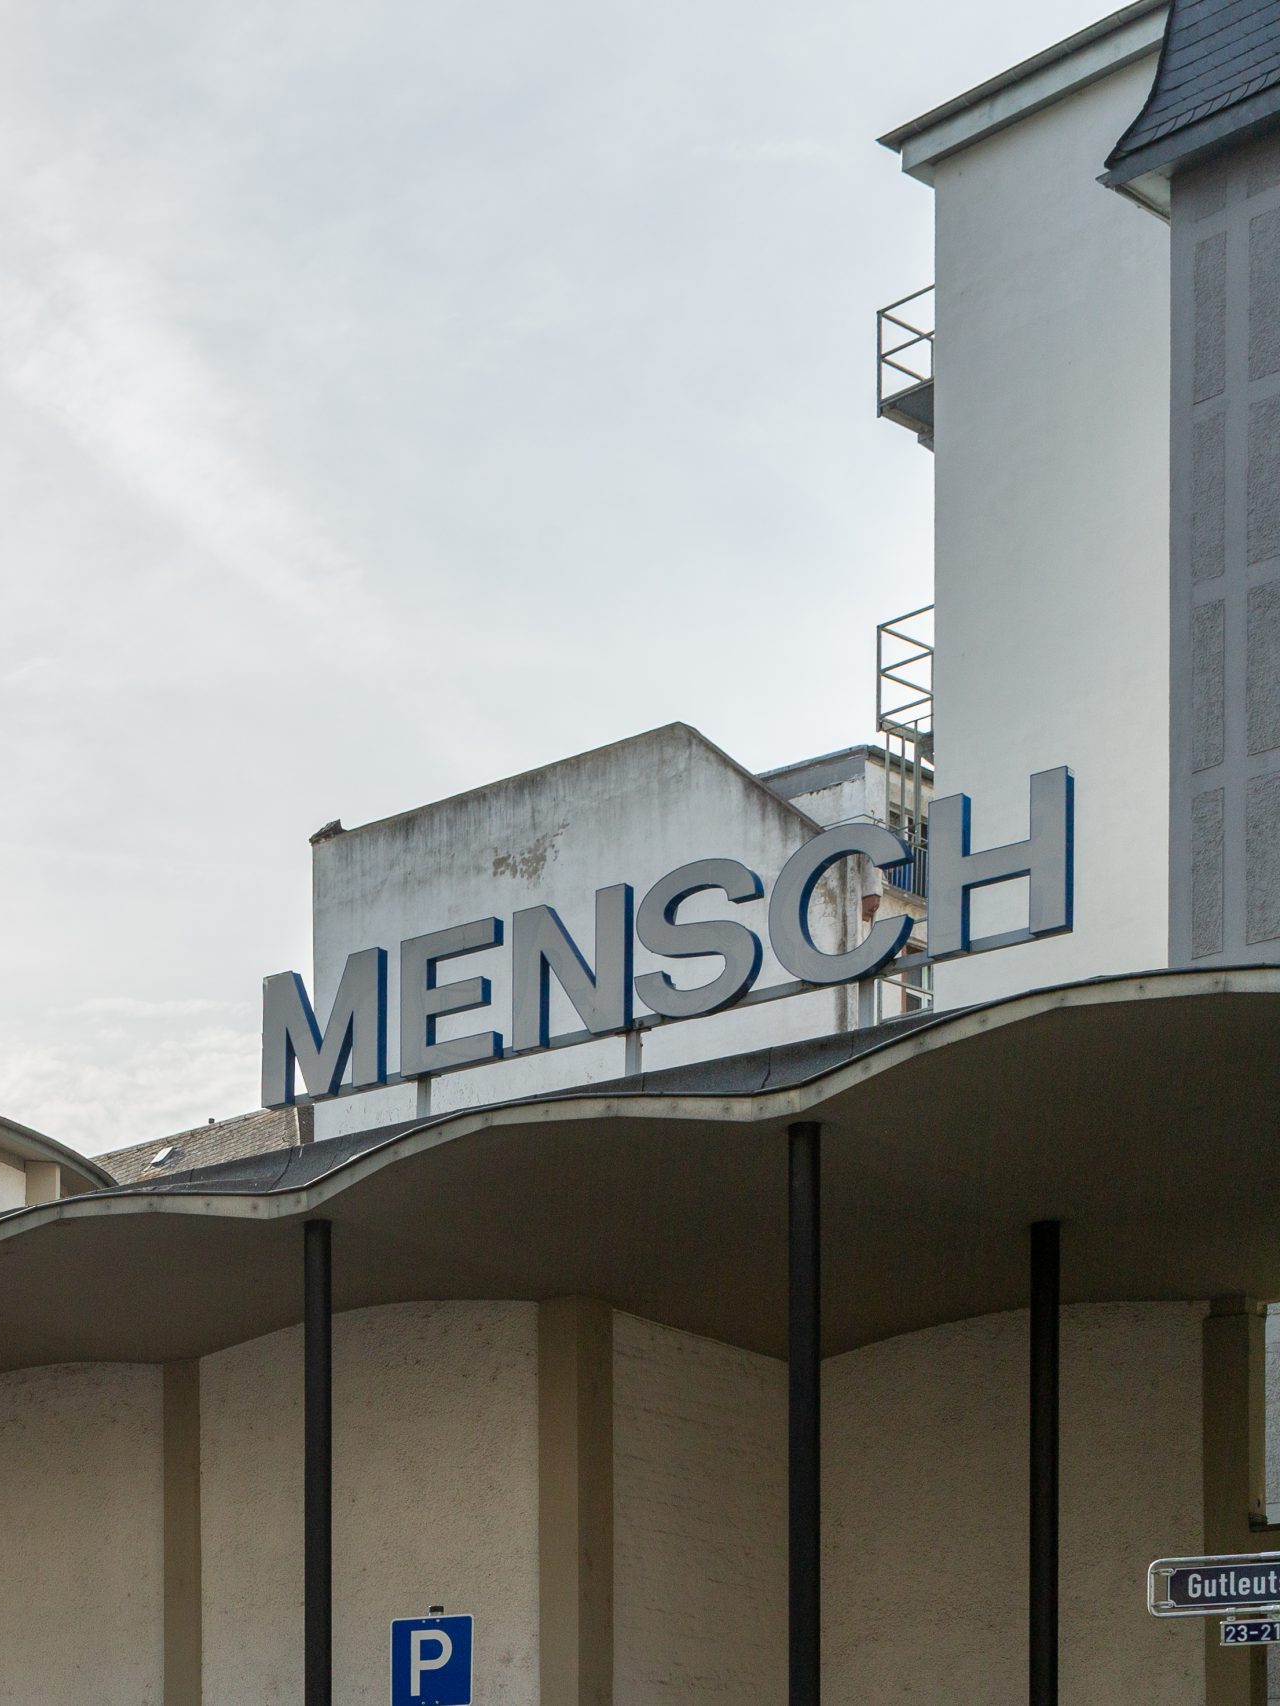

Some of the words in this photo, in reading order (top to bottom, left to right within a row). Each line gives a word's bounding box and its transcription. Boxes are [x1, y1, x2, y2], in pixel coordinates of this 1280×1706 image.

[261, 765, 1074, 1108] MENSCH
[1188, 1570, 1280, 1598] Gutleut
[1225, 1623, 1280, 1643] 23-21
[410, 1629, 453, 1696] P
